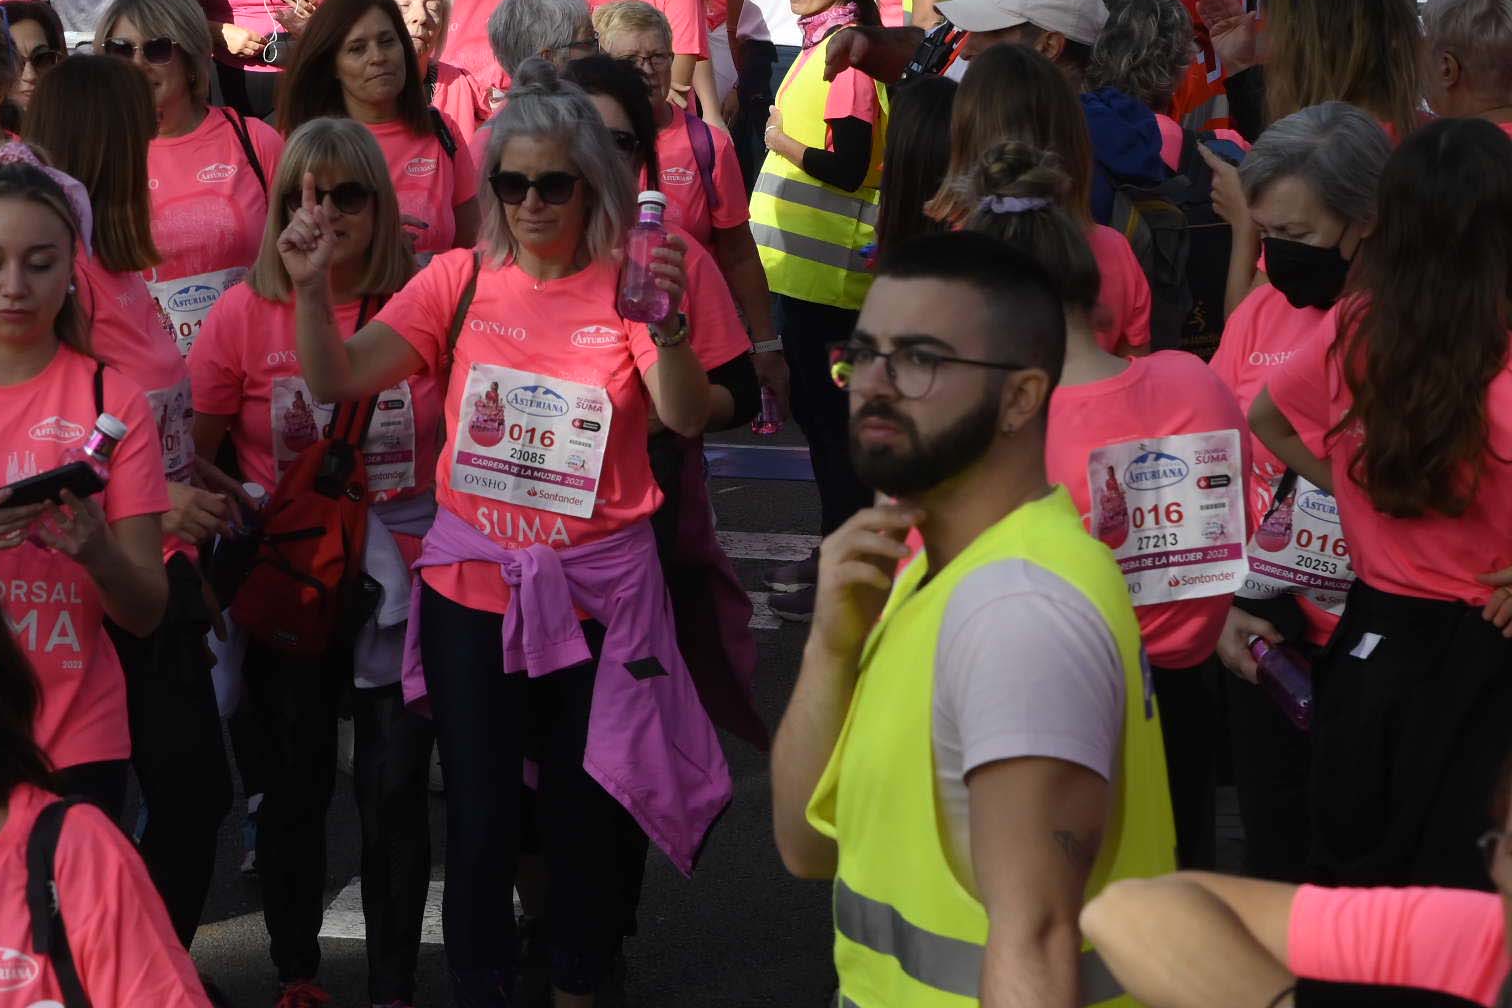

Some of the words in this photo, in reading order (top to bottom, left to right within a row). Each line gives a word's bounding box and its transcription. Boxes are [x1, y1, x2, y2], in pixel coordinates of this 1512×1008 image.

[172, 294, 216, 308] ASTURIANA
[470, 318, 526, 341] OYSHO
[267, 352, 297, 366] OYS
[510, 392, 564, 414] ASTURIANA
[575, 401, 603, 414] SUMA
[509, 423, 555, 448] 016
[471, 457, 510, 470] CARRERA
[521, 466, 532, 475] LA
[533, 469, 562, 482] MUJER
[565, 475, 584, 486] 2023
[1128, 466, 1185, 485] ASTURIANA
[1195, 454, 1228, 465] SUMA
[464, 474, 507, 491] OYSHO
[537, 488, 584, 506] Santander
[474, 506, 571, 545] SUMA
[1132, 501, 1184, 530] 016
[1136, 533, 1178, 551] 27213
[1295, 528, 1348, 557] 016
[1140, 556, 1153, 569] DE
[1154, 555, 1167, 566] LA
[1168, 551, 1203, 564] MUJER
[1206, 548, 1228, 559] 2023
[1295, 555, 1338, 575] 20253
[1181, 570, 1235, 587] Santander
[1253, 562, 1294, 580] CARRERA
[1295, 574, 1308, 584] DE
[1309, 576, 1322, 586] LA
